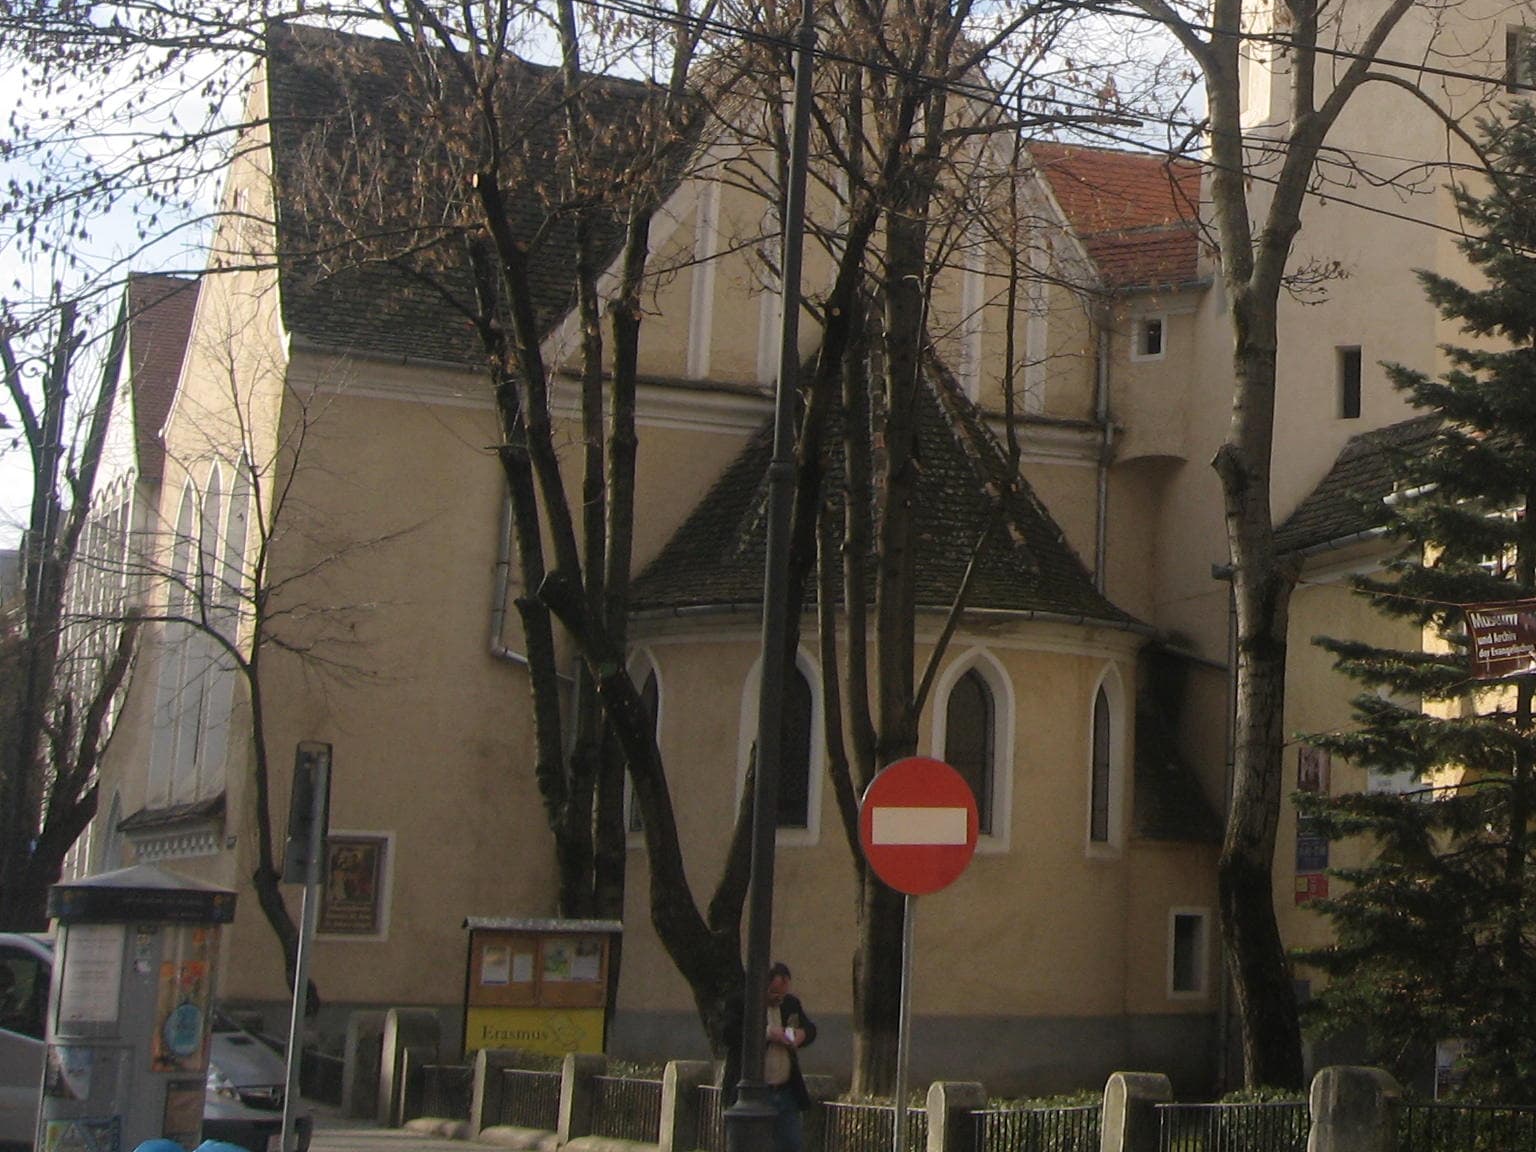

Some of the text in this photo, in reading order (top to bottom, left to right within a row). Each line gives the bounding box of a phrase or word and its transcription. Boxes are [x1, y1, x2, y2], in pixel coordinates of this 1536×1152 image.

[1470, 613, 1518, 629] Museum
[1477, 630, 1517, 646] und Archiv
[482, 1026, 547, 1041] Erasmus
